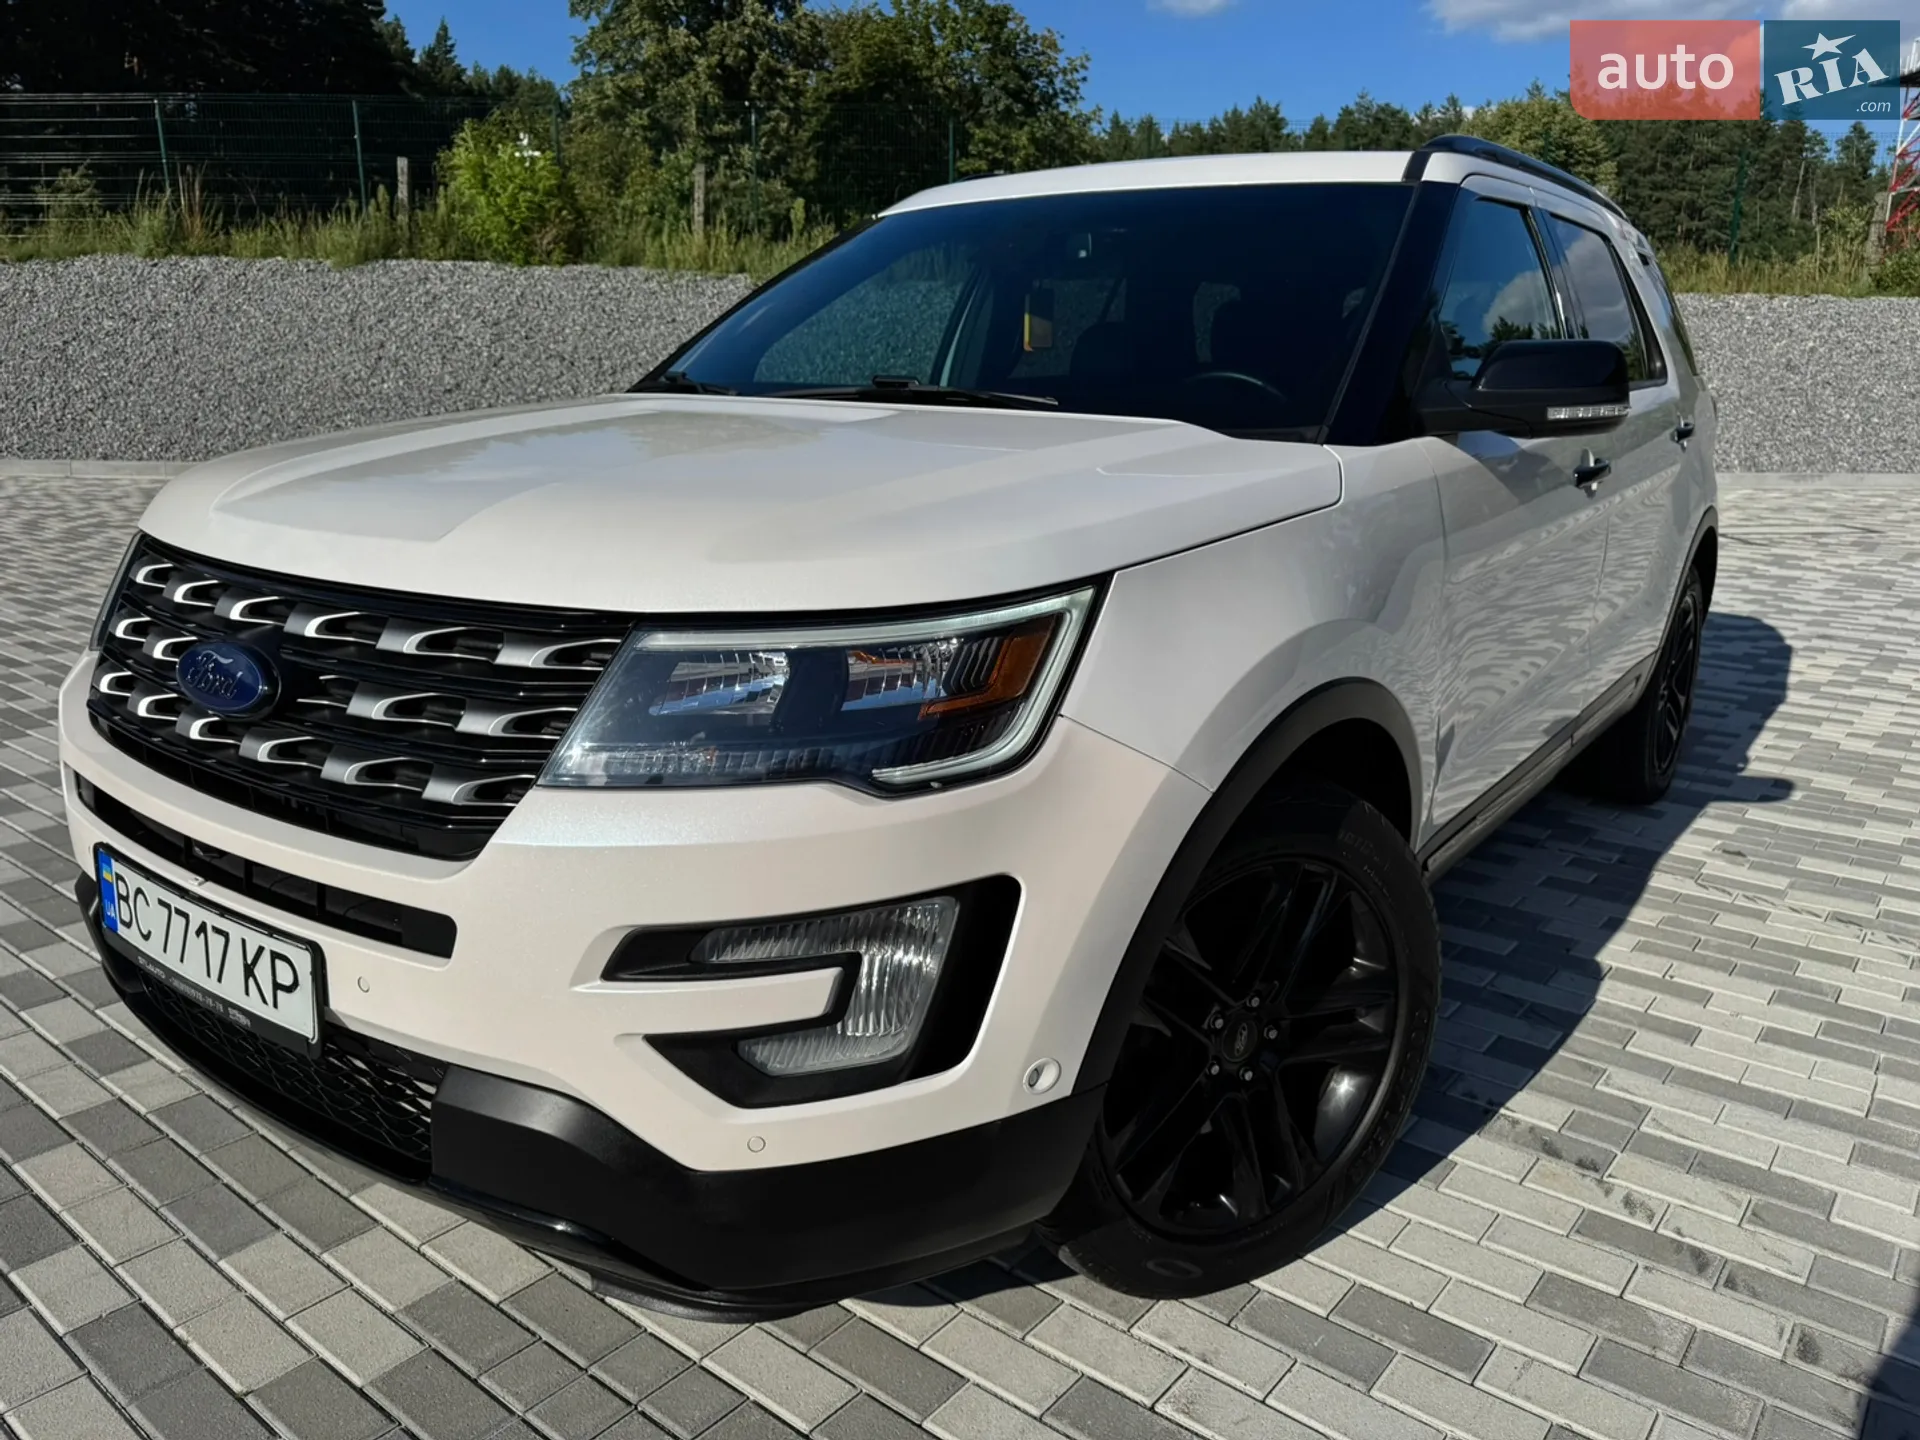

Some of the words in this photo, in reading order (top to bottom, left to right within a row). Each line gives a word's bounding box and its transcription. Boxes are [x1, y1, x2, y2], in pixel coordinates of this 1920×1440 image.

[114, 871, 152, 941] BC
[157, 897, 230, 984] 7717
[240, 937, 300, 1010] KP
